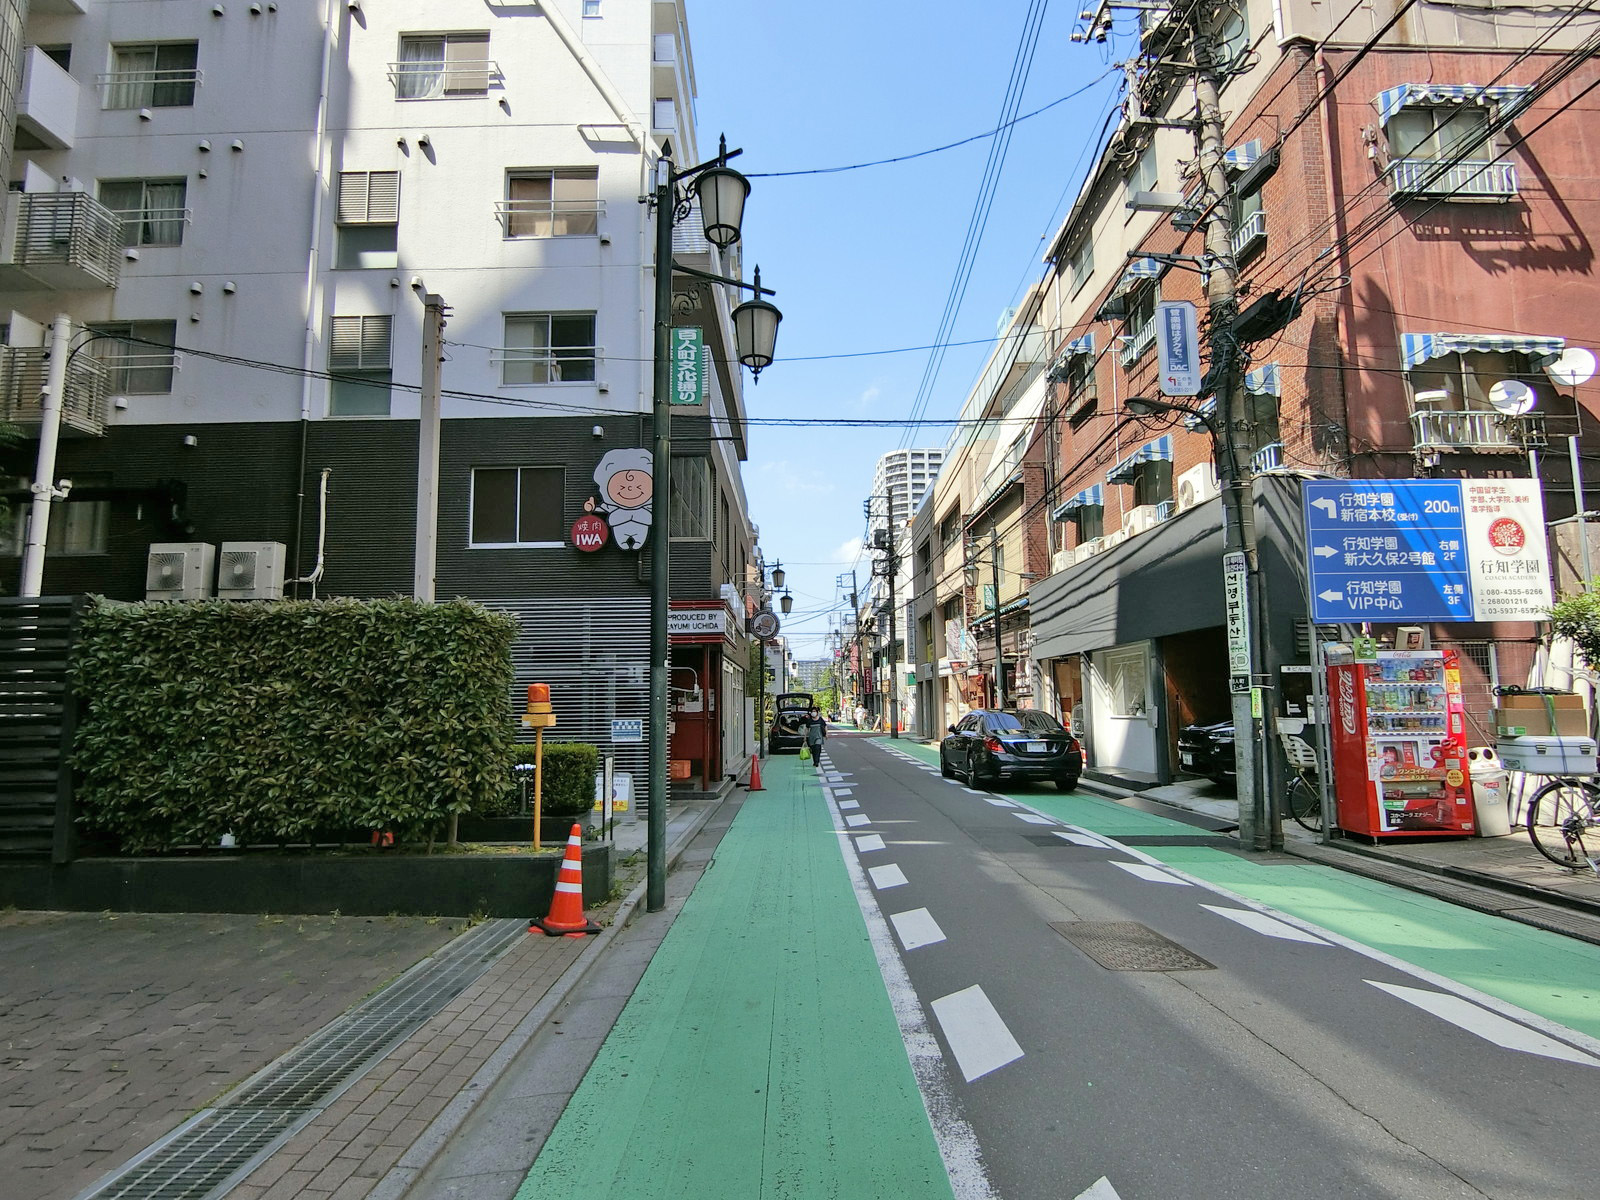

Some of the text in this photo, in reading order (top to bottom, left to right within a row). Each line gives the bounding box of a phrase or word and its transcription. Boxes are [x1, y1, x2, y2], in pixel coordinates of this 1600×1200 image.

[677, 329, 697, 402] 百人町文化通り
[1469, 486, 1507, 494] 中国留学生
[1339, 492, 1394, 507] 行知学園
[1424, 500, 1459, 514] 200m
[1340, 508, 1396, 522] 新宿本校
[577, 520, 602, 532] 焼肉
[576, 533, 603, 546] IWA
[1343, 536, 1398, 551] 行知学園
[1438, 540, 1459, 551] 右側
[1344, 551, 1436, 566] 新大久保2号館
[1443, 552, 1457, 561] 2F
[1480, 559, 1540, 574] 行知学園
[1346, 580, 1402, 595] 行知学園
[1443, 584, 1464, 595] 左側
[1347, 596, 1403, 610] VIP中心
[1447, 596, 1461, 605] 3F
[692, 622, 719, 630] UCHIDA
